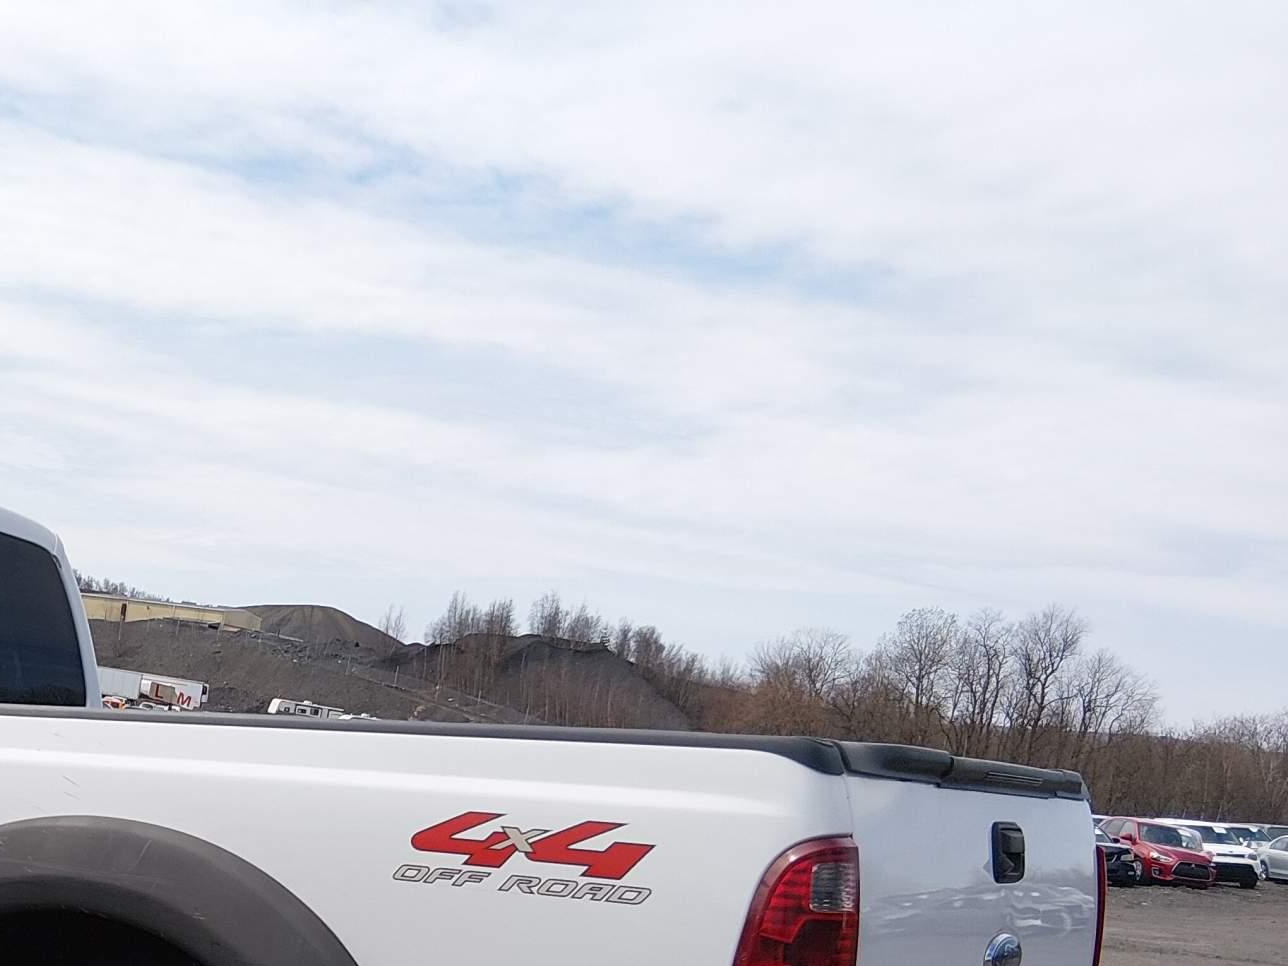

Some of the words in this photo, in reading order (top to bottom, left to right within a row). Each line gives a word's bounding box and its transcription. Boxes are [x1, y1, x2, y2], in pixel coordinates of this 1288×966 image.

[176, 691, 192, 707] M
[393, 864, 491, 887] OFF
[498, 875, 652, 905] ROAD
